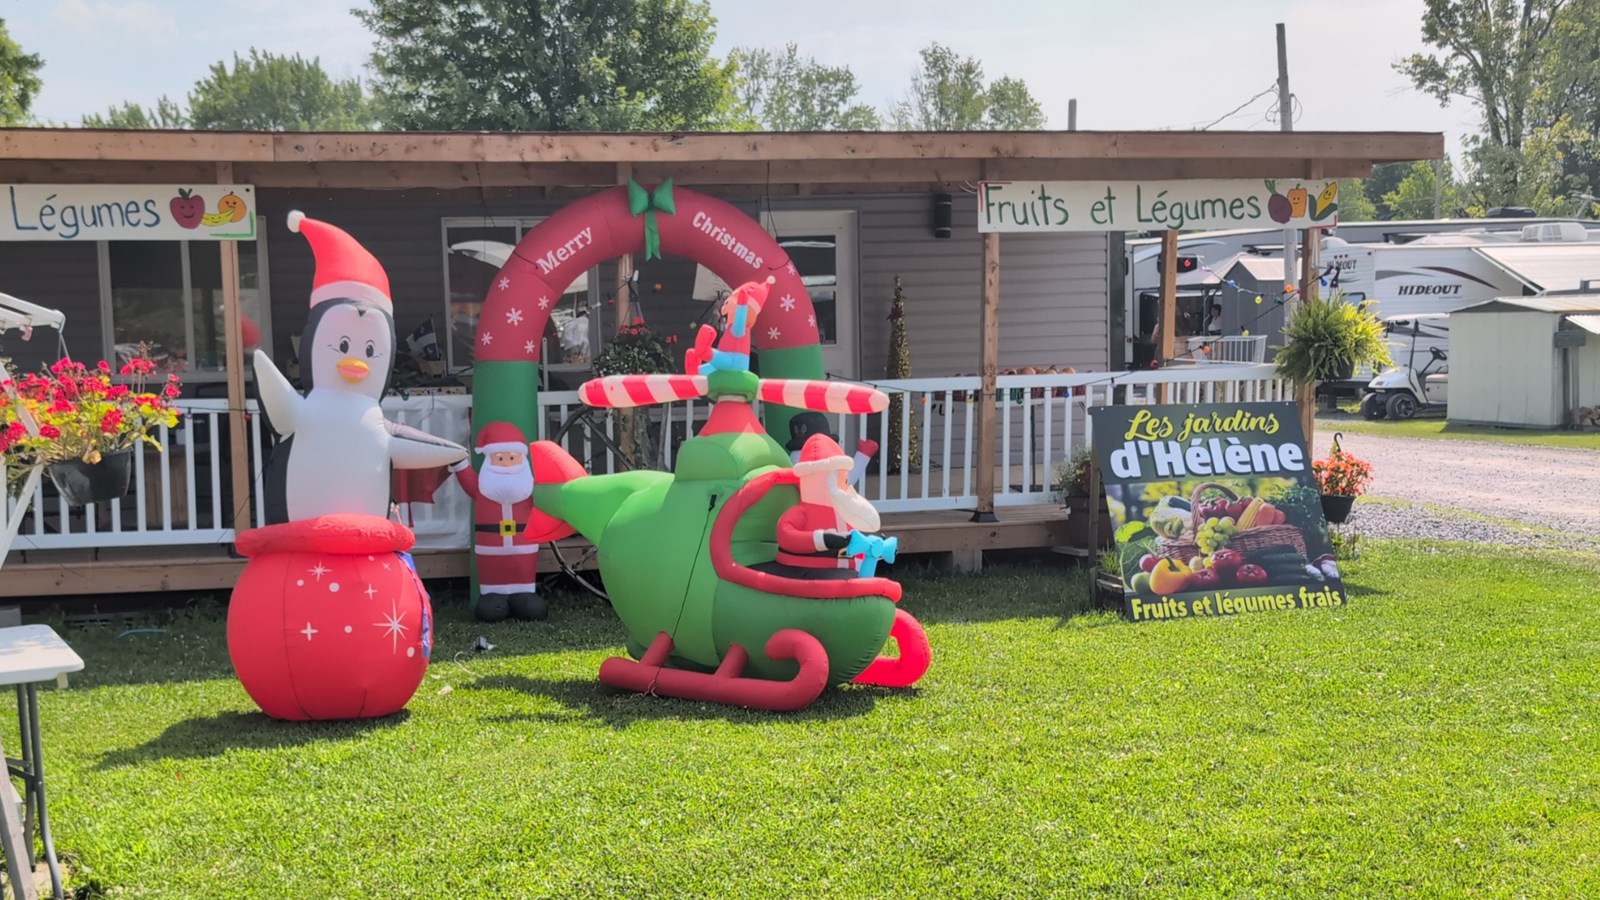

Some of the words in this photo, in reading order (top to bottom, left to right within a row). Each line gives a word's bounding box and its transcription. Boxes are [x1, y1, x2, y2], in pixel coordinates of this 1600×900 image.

[9, 186, 160, 239] Légumes
[983, 184, 1069, 226] Fruits
[1090, 186, 1116, 225] et
[1137, 185, 1261, 229] Légumes
[536, 227, 593, 275] Merry
[692, 211, 764, 269] Christmas
[1397, 284, 1462, 296] HIDEOUT
[1124, 409, 1173, 441] Les
[1177, 410, 1279, 441] jardins
[1110, 437, 1305, 478] d'Hélène
[1131, 596, 1188, 620] Fruits
[1192, 596, 1213, 615] et
[1215, 592, 1296, 614] légumes
[1299, 586, 1342, 608] frais
